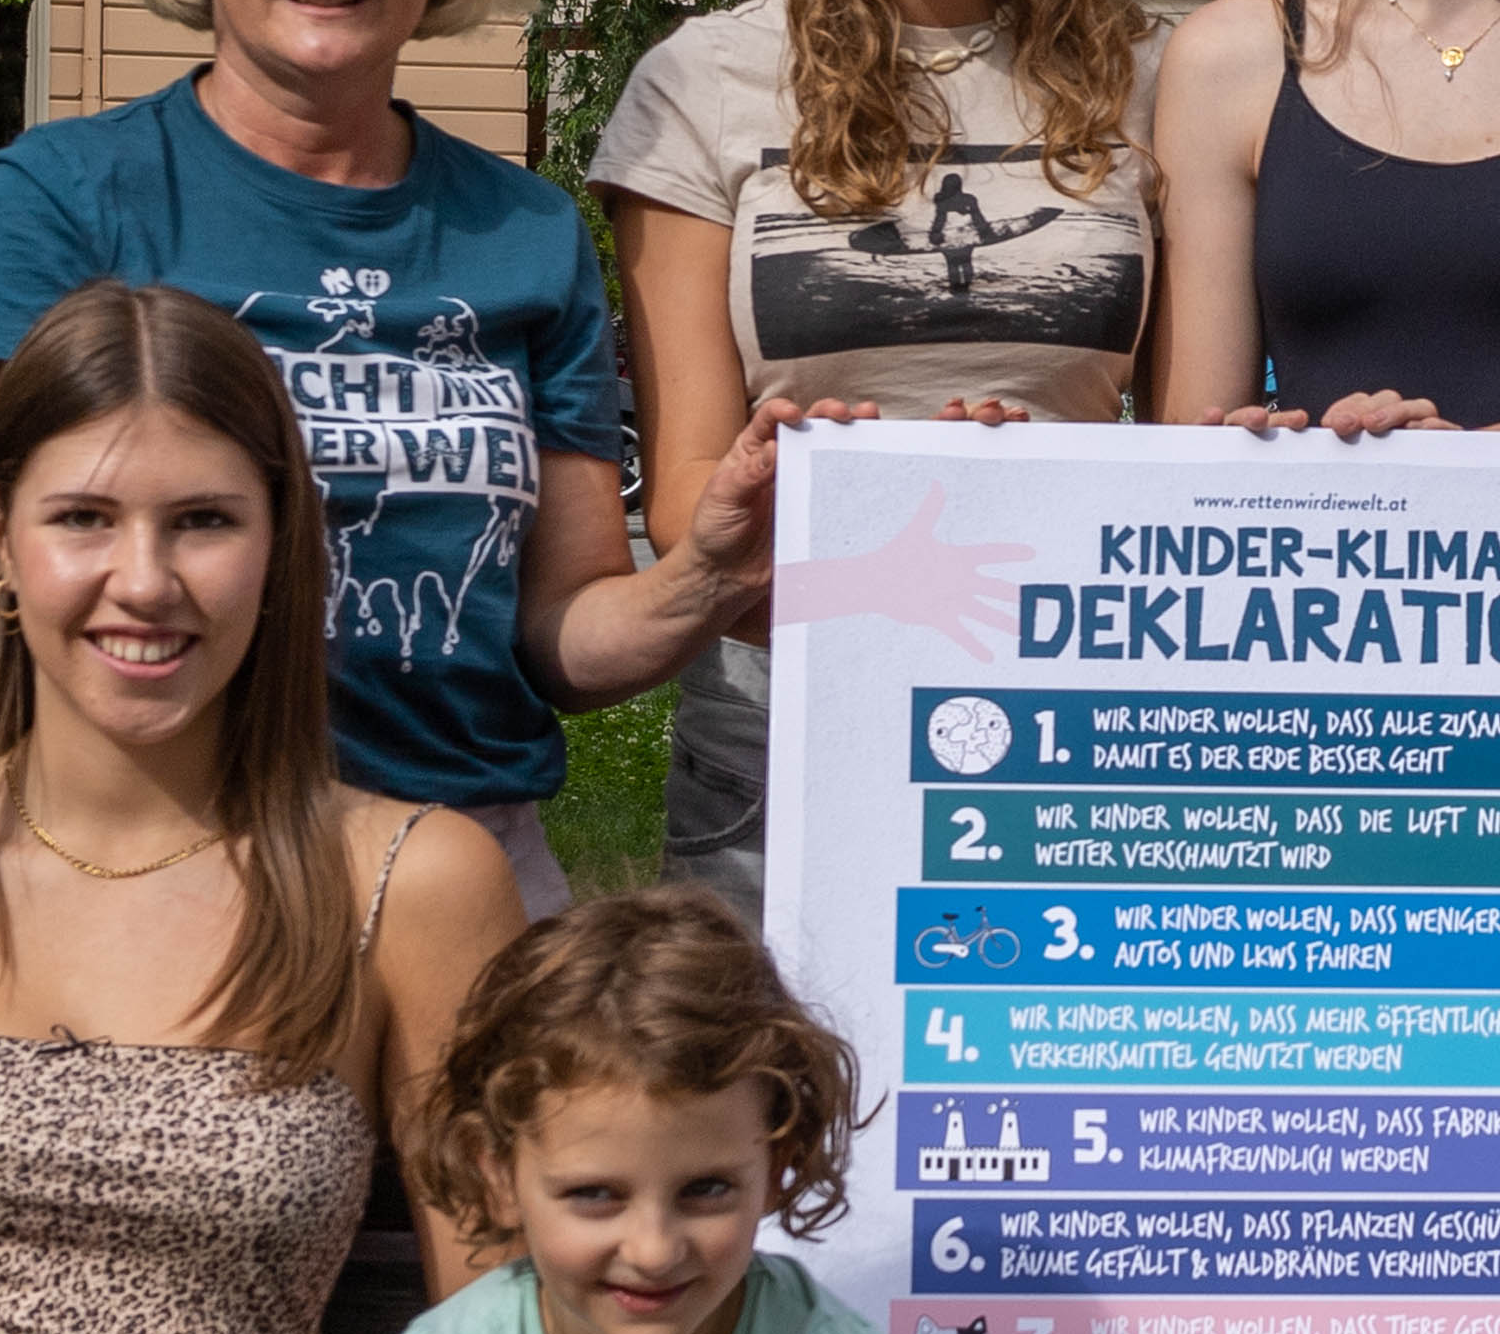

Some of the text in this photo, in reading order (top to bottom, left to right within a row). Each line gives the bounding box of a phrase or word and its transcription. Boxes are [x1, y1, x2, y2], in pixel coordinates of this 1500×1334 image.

[290, 361, 519, 413] CHT MIT
[311, 426, 537, 493] ER WEL
[1192, 492, 1409, 513] www.rettenwirdiewelt.at
[1035, 711, 1070, 763] 1.
[1092, 706, 1135, 732] WIR
[1139, 706, 1220, 735] KINDER
[1223, 708, 1318, 740] WOLLEN,
[1326, 707, 1374, 738] DASS
[1380, 710, 1434, 737] ALLE
[1093, 741, 1454, 775] DAMIT ES DER ERDE BESSER GEHT
[951, 807, 1002, 860] 2.
[1035, 803, 1078, 829] WIR
[1090, 803, 1172, 832] KINDER
[1183, 805, 1278, 837] WOLLEN,
[1295, 804, 1343, 835] DASS
[1359, 808, 1393, 833] DIE
[1407, 805, 1468, 838] LUFT
[1034, 838, 1332, 872] WEITER VERSCHMUTZT WIRD
[1043, 906, 1094, 960] 3.
[1114, 904, 1157, 930] WIR
[1161, 903, 1242, 932] KINDER
[1245, 905, 1341, 937] WOLLEN,
[1350, 904, 1397, 935] DASS
[1113, 939, 1392, 973] AUTOS UND LKWS FAHREN
[925, 1008, 979, 1062] 4.
[1009, 1004, 1053, 1031] WIR
[1057, 1004, 1139, 1033] KINDER
[1143, 1005, 1239, 1038] WOLLEN,
[1249, 1004, 1297, 1035] DASS
[1304, 1006, 1371, 1034] MEHR
[1009, 1039, 1403, 1073] VERKEHRSMITTEL GENUTZT WERDEN
[1074, 1109, 1123, 1163] 5.
[1139, 1106, 1182, 1134] WIR
[1186, 1106, 1268, 1136] KINDER
[1271, 1106, 1367, 1140] WOLLEN,
[1376, 1106, 1424, 1137] DASS
[1139, 1142, 1430, 1176] KLIMAFREUNDLICH WERDEN
[1000, 1210, 1044, 1238] WIR
[1049, 1210, 1131, 1240] KINDER
[1136, 1210, 1233, 1244] WOLLEN,
[1243, 1209, 1291, 1241] DASS
[1301, 1209, 1415, 1243] PFLANZEN
[931, 1217, 984, 1272] 6.
[1000, 1244, 1080, 1279] BÄUME
[1085, 1244, 1189, 1280] GEFÄLLT
[1191, 1248, 1210, 1280] &
[1215, 1245, 1361, 1280] WALDBRÄNDE
